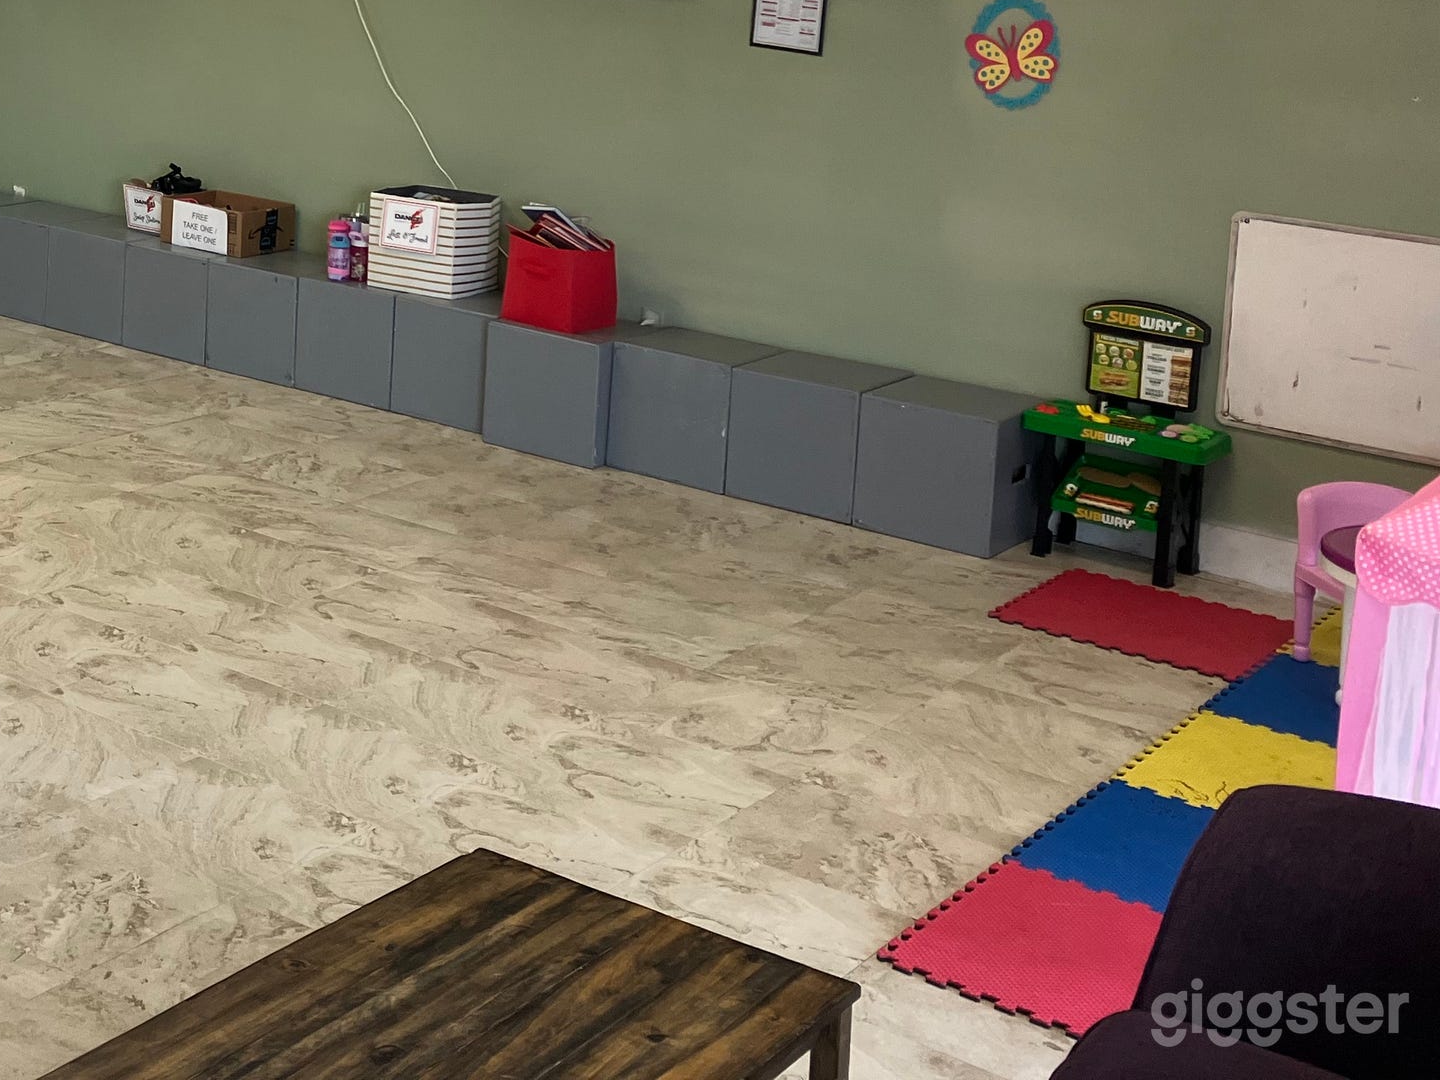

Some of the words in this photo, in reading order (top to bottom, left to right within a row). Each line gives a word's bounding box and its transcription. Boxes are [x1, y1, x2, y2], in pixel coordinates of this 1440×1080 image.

[191, 211, 209, 222] FREE
[183, 220, 199, 231] TAKE
[200, 224, 214, 234] ONE
[182, 232, 202, 243] LEAVE
[203, 236, 217, 246] ONE
[1106, 310, 1182, 333] SUBWAY
[1080, 428, 1136, 447] SUBWAY
[1073, 507, 1136, 529] SUBWAY
